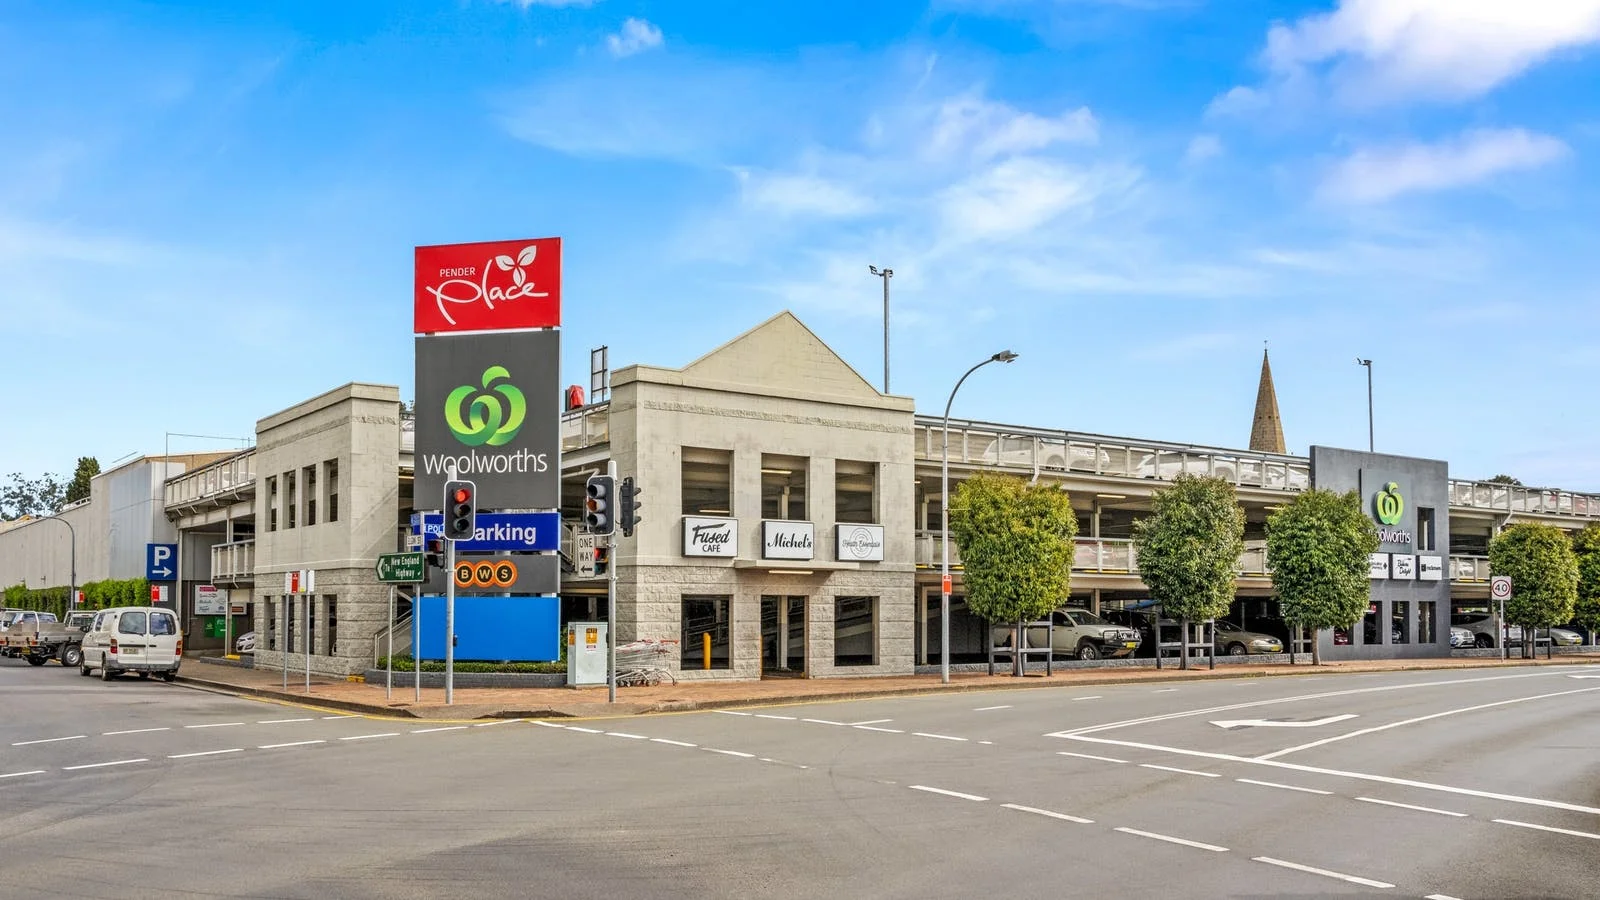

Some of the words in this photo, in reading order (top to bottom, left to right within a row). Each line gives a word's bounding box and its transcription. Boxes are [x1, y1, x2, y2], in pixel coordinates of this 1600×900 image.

[439, 267, 476, 277] PENDER
[423, 448, 548, 475] Woolworths
[474, 523, 537, 545] arking
[692, 523, 730, 546] Fused
[767, 533, 812, 549] Michel's
[1370, 528, 1411, 544] olworths
[579, 537, 593, 548] ONE
[154, 546, 171, 567] P
[385, 563, 390, 572] To
[391, 557, 401, 566] New
[401, 555, 420, 567] England
[579, 551, 593, 561] WAY
[395, 568, 415, 579] Highway
[1494, 584, 1508, 592] 40
